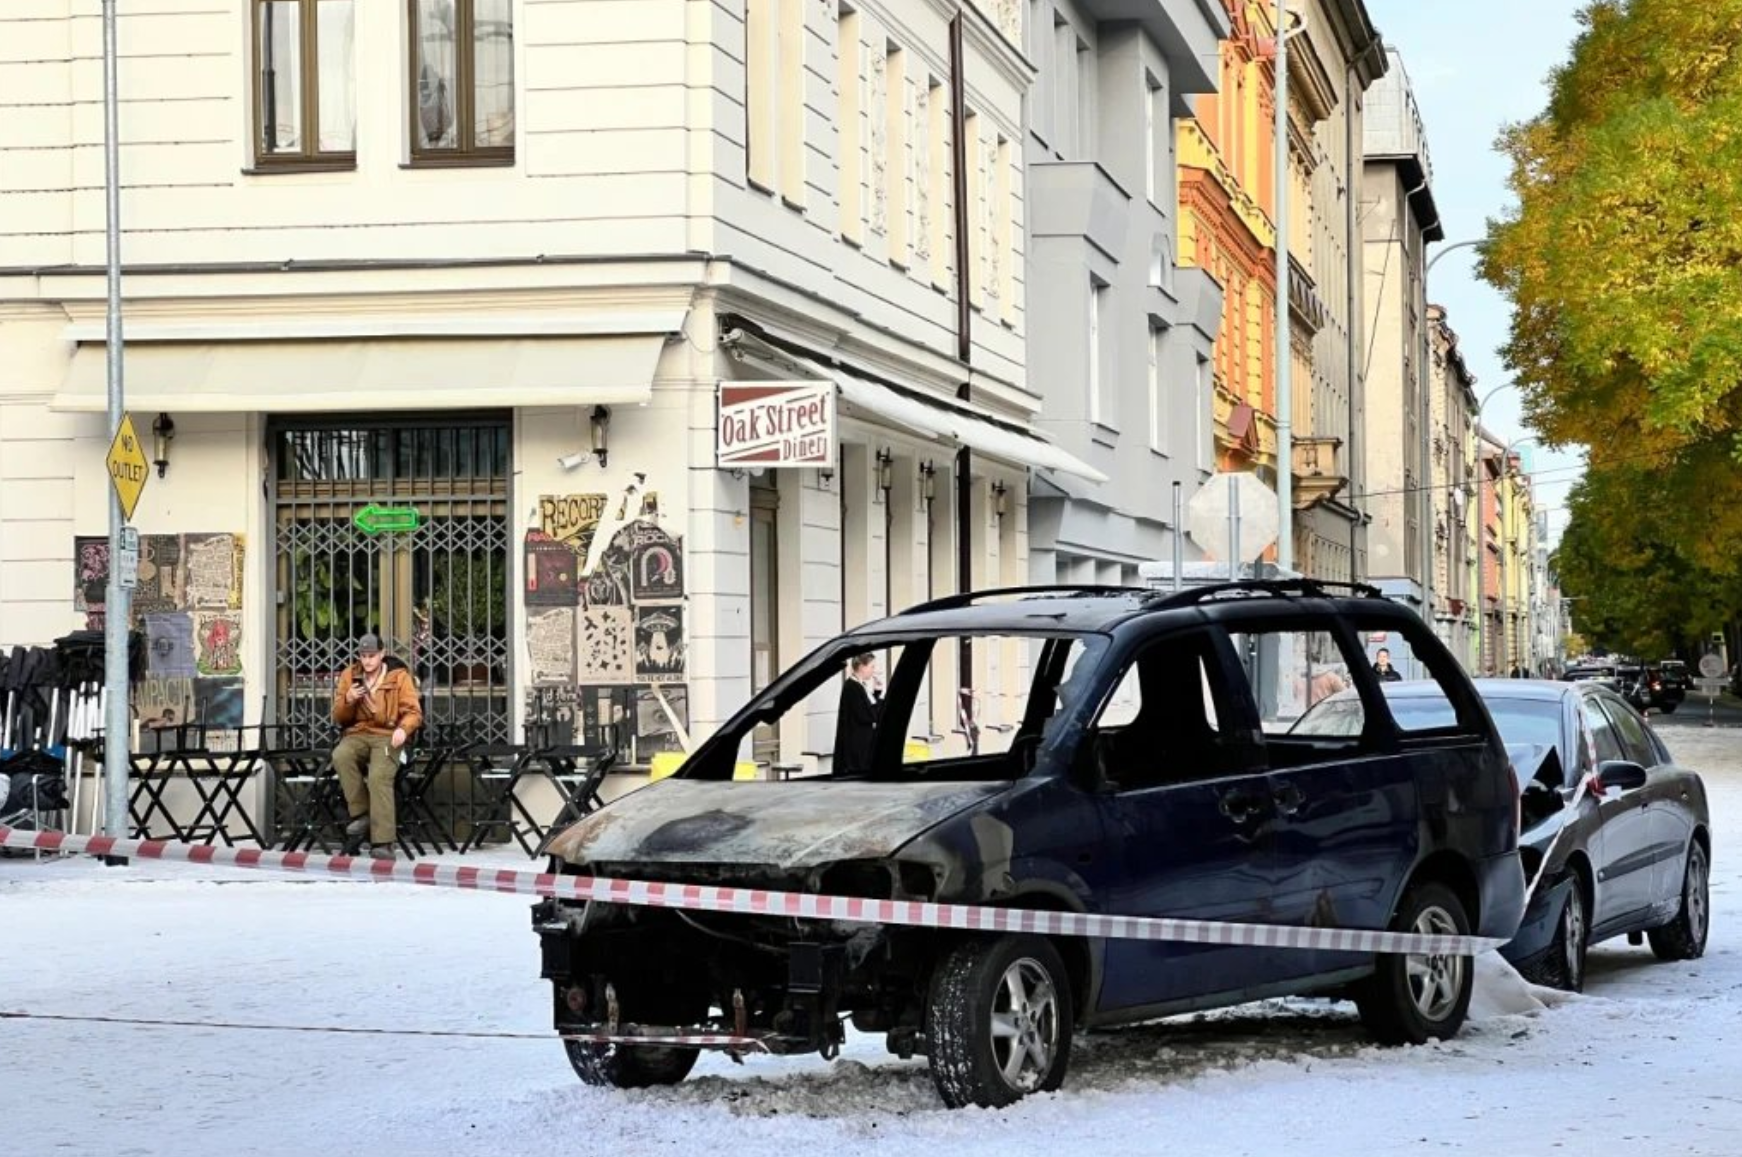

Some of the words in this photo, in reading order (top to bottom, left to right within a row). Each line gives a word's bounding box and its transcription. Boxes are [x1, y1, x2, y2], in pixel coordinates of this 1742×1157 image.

[722, 408, 760, 447] Oak
[765, 394, 827, 436] Street
[121, 434, 133, 452] NO
[782, 437, 822, 461] Diner
[113, 460, 143, 481] OUTLET
